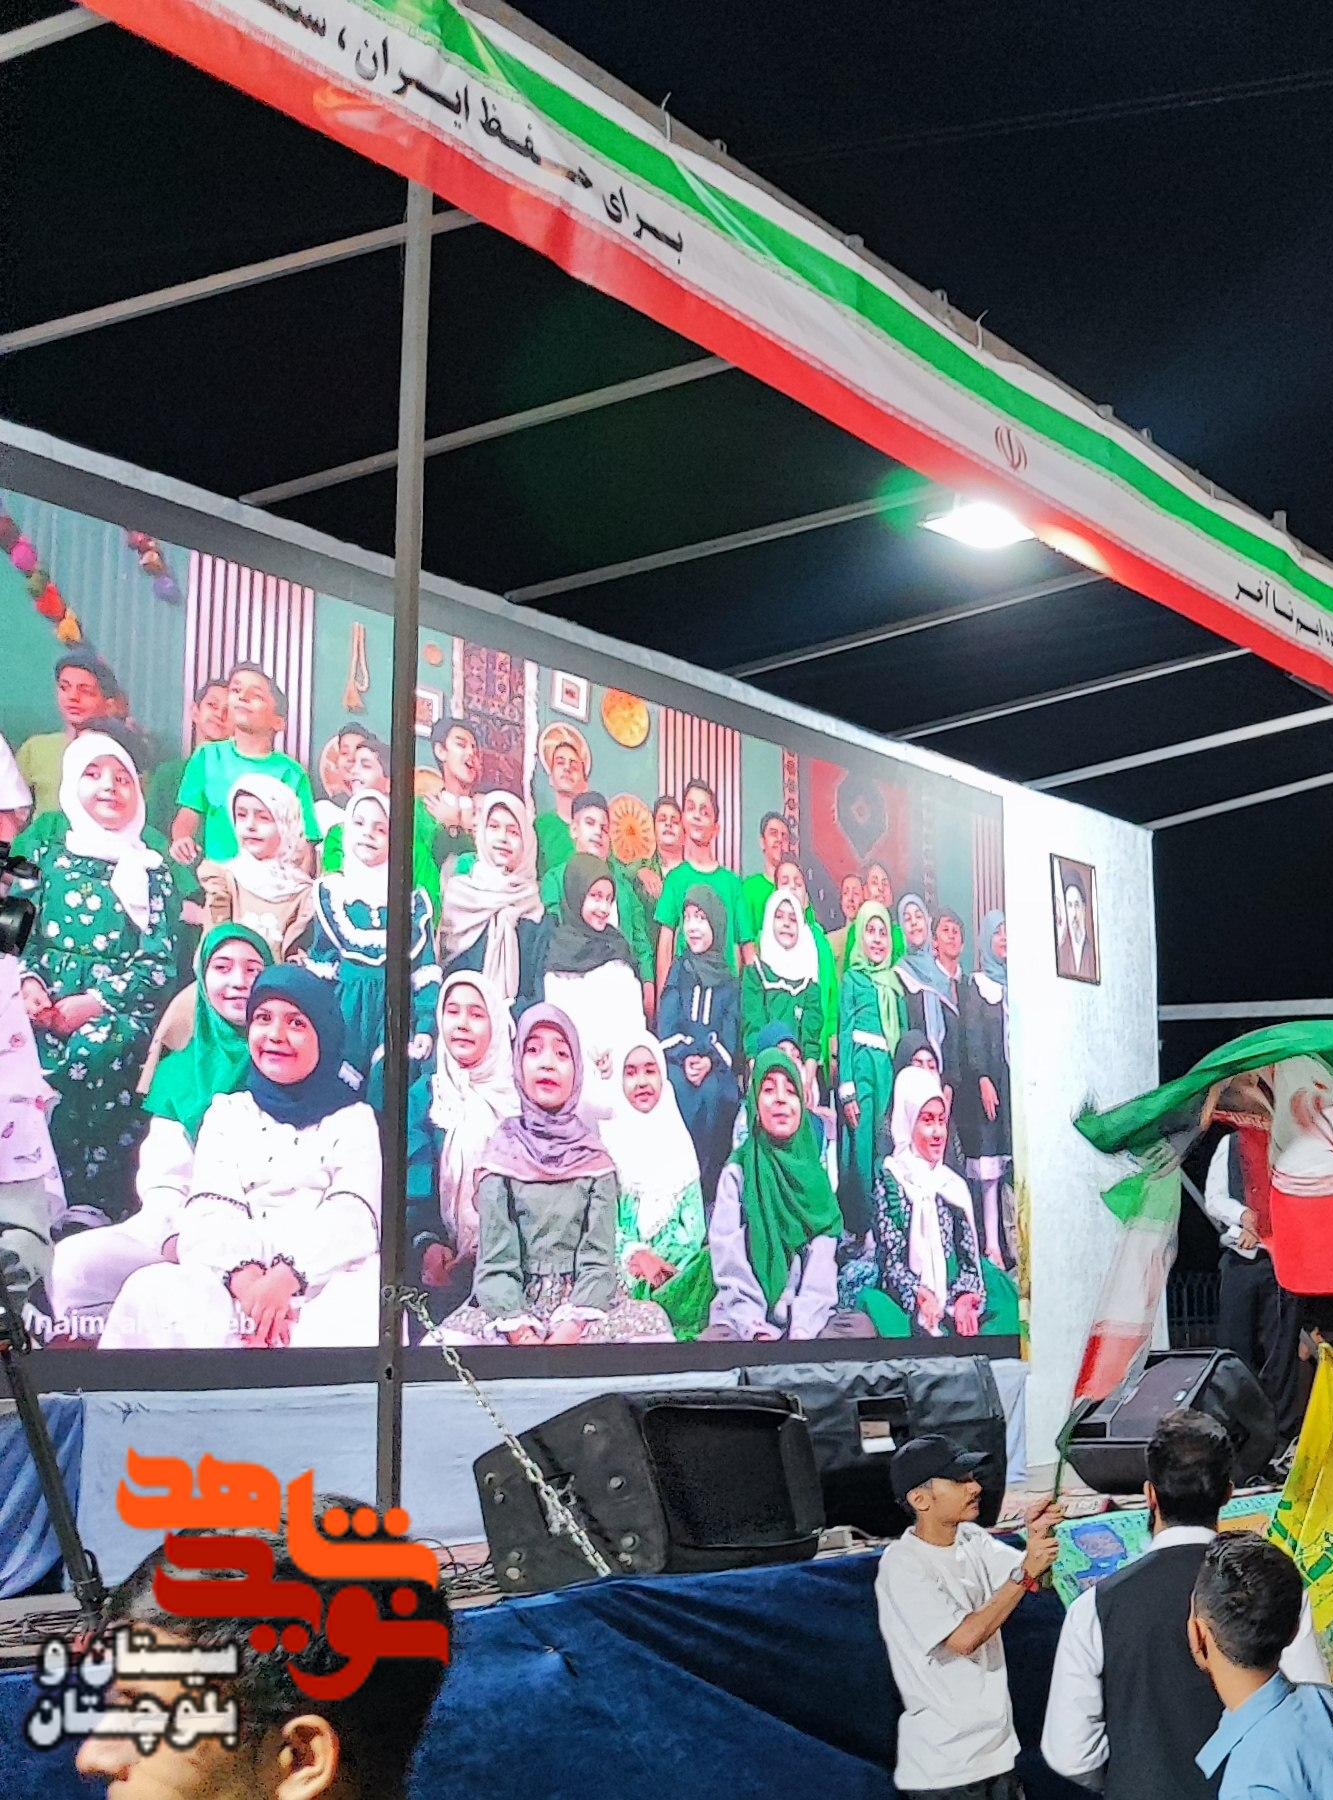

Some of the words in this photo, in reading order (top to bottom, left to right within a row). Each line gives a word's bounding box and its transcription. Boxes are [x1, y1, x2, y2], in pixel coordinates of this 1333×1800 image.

[354, 35, 469, 130] ایران
[479, 96, 593, 189] حفظ
[602, 185, 684, 265] برای
[1234, 579, 1270, 609] آخر
